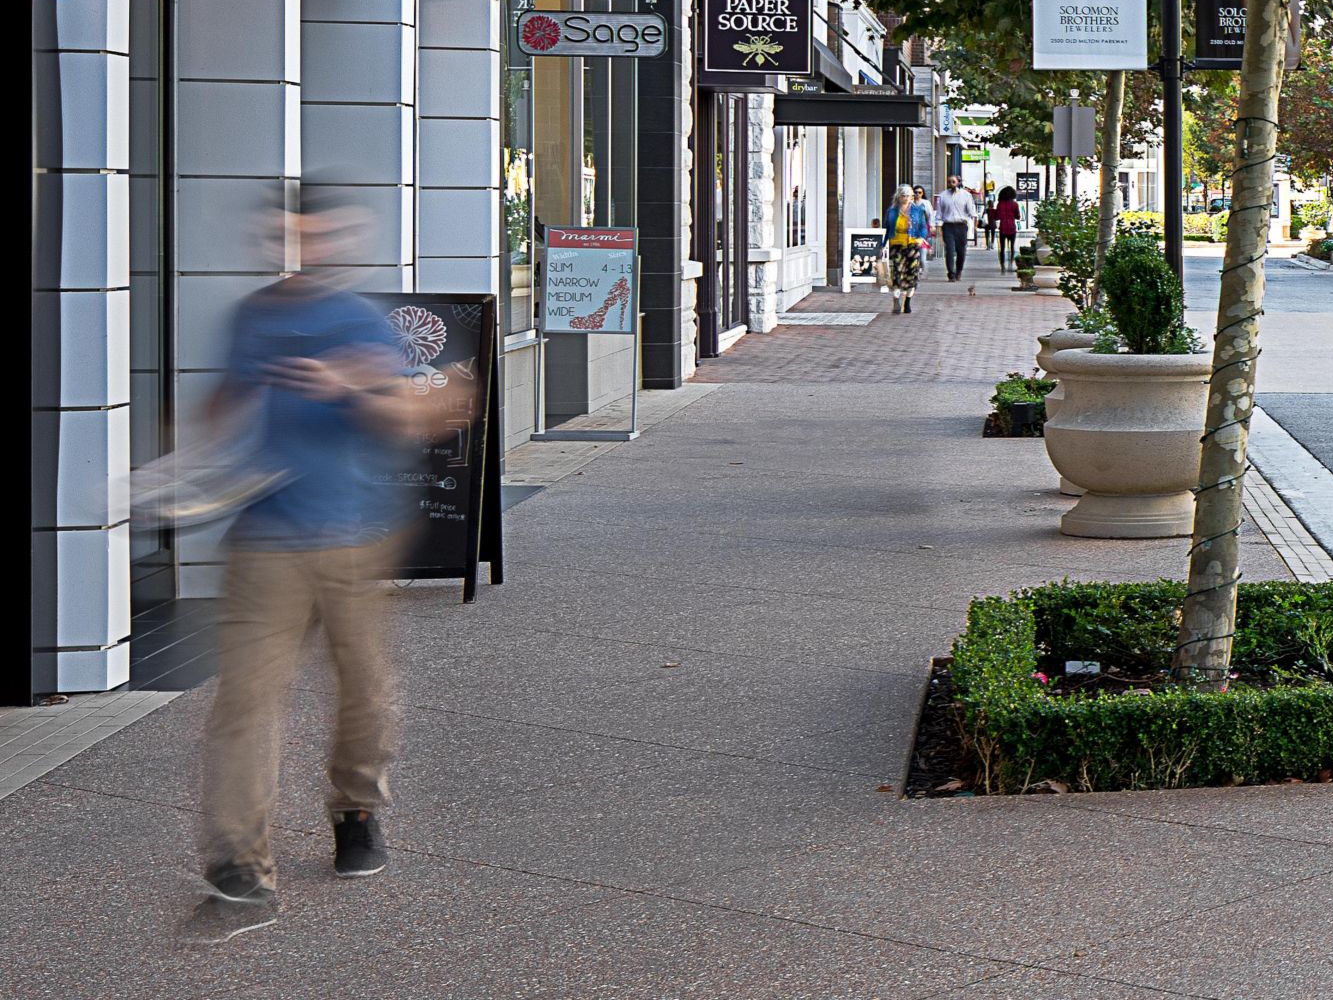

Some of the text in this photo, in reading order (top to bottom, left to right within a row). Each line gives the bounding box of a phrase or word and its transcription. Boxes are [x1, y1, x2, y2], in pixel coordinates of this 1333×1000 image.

[1059, 5, 1119, 16] SOLOMON
[1218, 7, 1248, 17] SOLO
[718, 14, 798, 32] SOURCE
[1060, 16, 1119, 26] BROTHERS
[1219, 17, 1247, 26] BROT
[564, 15, 662, 53] Sage
[1065, 25, 1114, 33] JEWELERS
[792, 83, 818, 94] drybar
[549, 262, 573, 273] SLIM
[601, 264, 608, 273] 4
[619, 264, 633, 274] 13
[548, 277, 600, 288] NARROW
[547, 291, 592, 302] MEDIUM
[547, 306, 576, 317] WIDE
